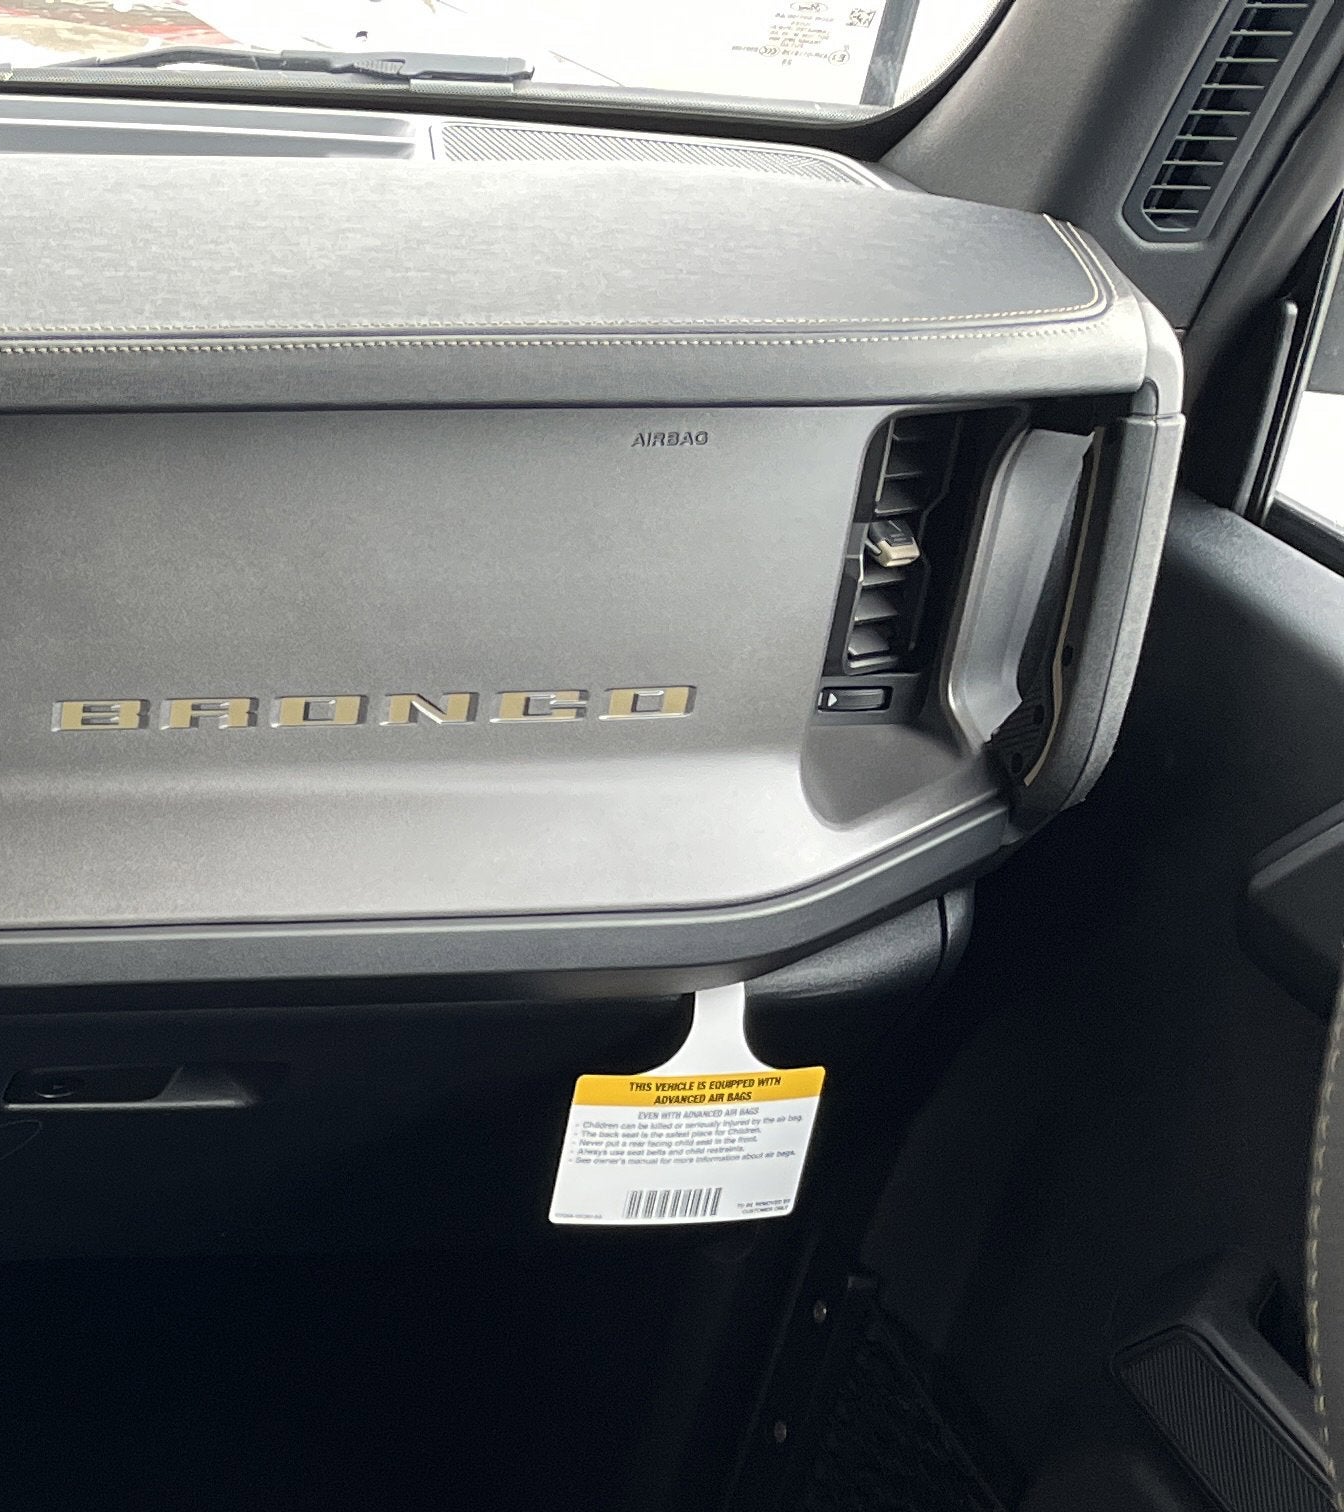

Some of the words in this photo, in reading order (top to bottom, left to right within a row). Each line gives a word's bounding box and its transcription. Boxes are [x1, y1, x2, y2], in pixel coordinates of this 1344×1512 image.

[631, 430, 709, 448] AIRBAG
[50, 684, 698, 733] BRONCO
[629, 1082, 652, 1092] THIS
[655, 1081, 694, 1092] VEHICLE
[697, 1080, 706, 1091] IS
[709, 1079, 755, 1090] EQUIPPED
[757, 1077, 782, 1087] WITH
[654, 1094, 706, 1105] ADVANCED
[708, 1093, 725, 1103] AIR
[727, 1091, 753, 1102] BAGS
[638, 1111, 658, 1120] EVEN
[661, 1111, 681, 1119] WITH
[682, 1109, 723, 1119] ADVANCED
[724, 1108, 737, 1117] AIR
[739, 1106, 760, 1116] BAGS
[583, 1121, 619, 1129] Children
[685, 1121, 721, 1130] seriously
[723, 1119, 750, 1129] injured
[582, 1130, 597, 1138] The
[599, 1130, 619, 1138] back
[675, 1139, 695, 1147] child
[577, 1148, 608, 1157] Always
[696, 1155, 741, 1163] information
[742, 1153, 764, 1161] about
